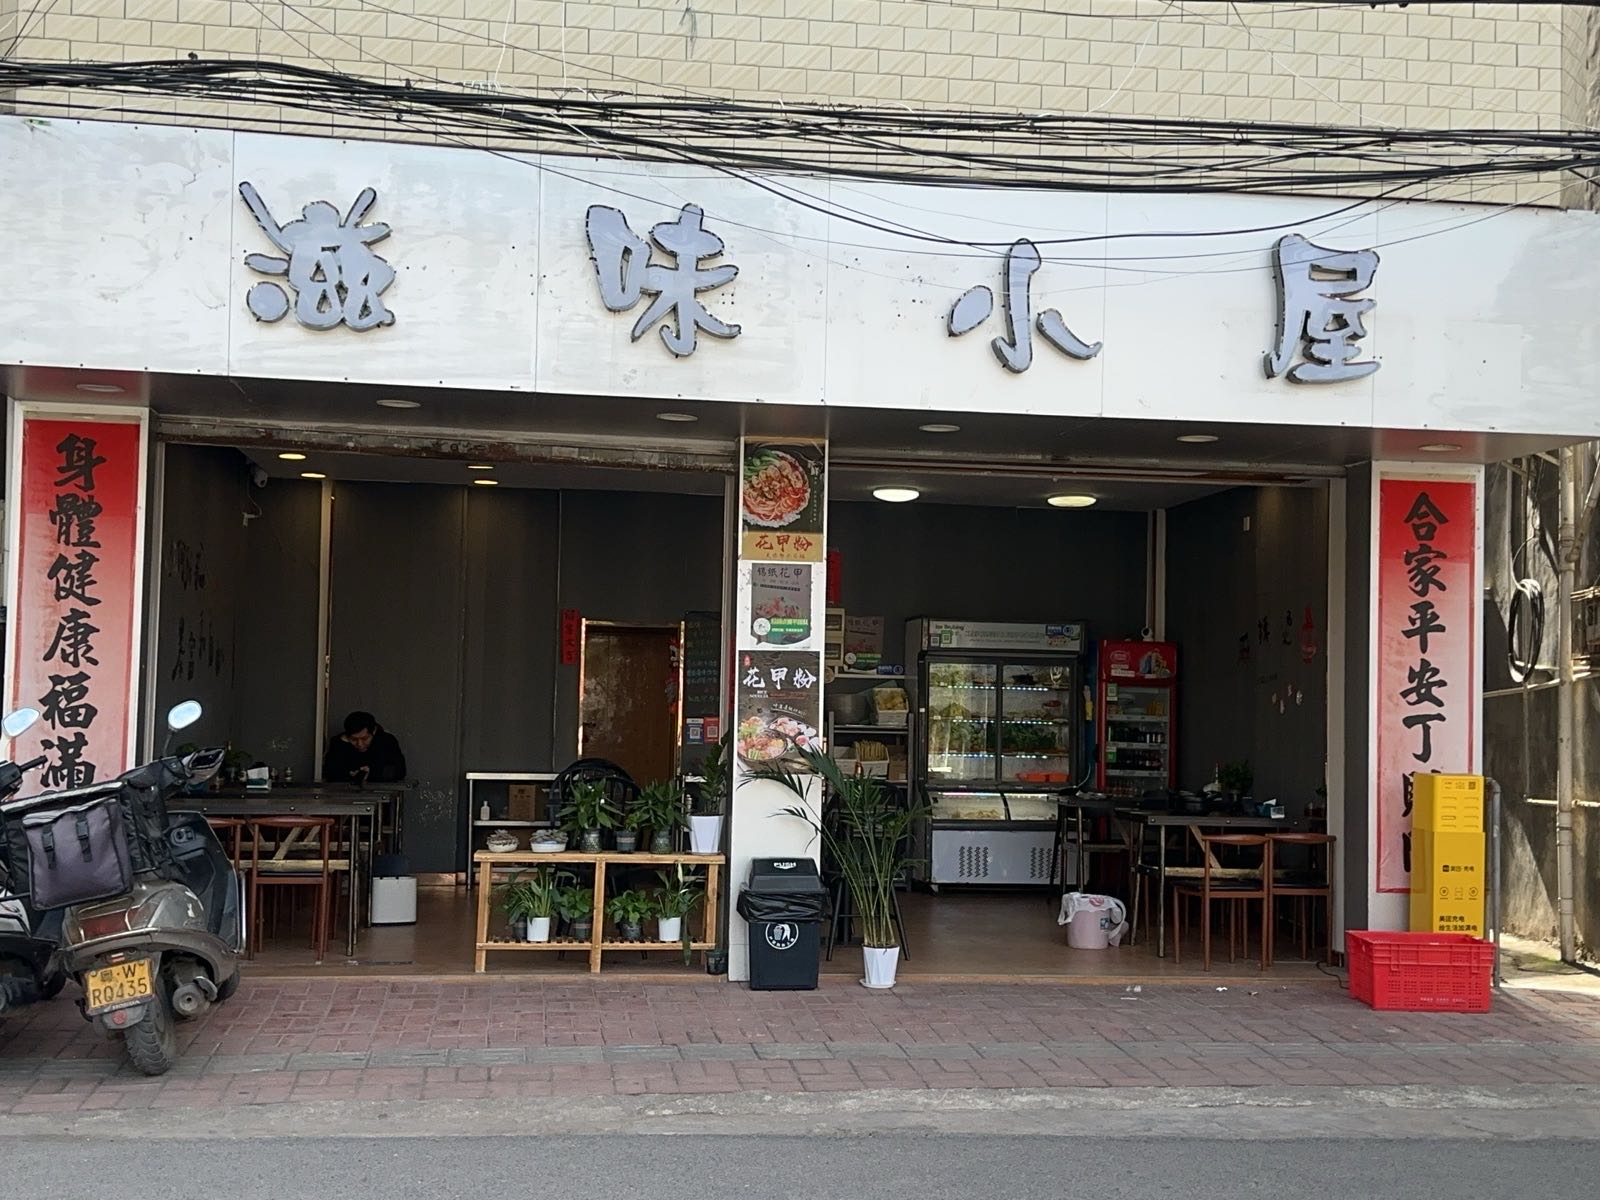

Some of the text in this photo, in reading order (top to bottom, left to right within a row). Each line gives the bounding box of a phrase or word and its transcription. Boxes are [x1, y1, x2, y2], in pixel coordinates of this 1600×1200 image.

[755, 533, 814, 553] 花甲粉
[742, 666, 817, 690] 花甲粉
[1400, 492, 1449, 873] 合家平安丁
